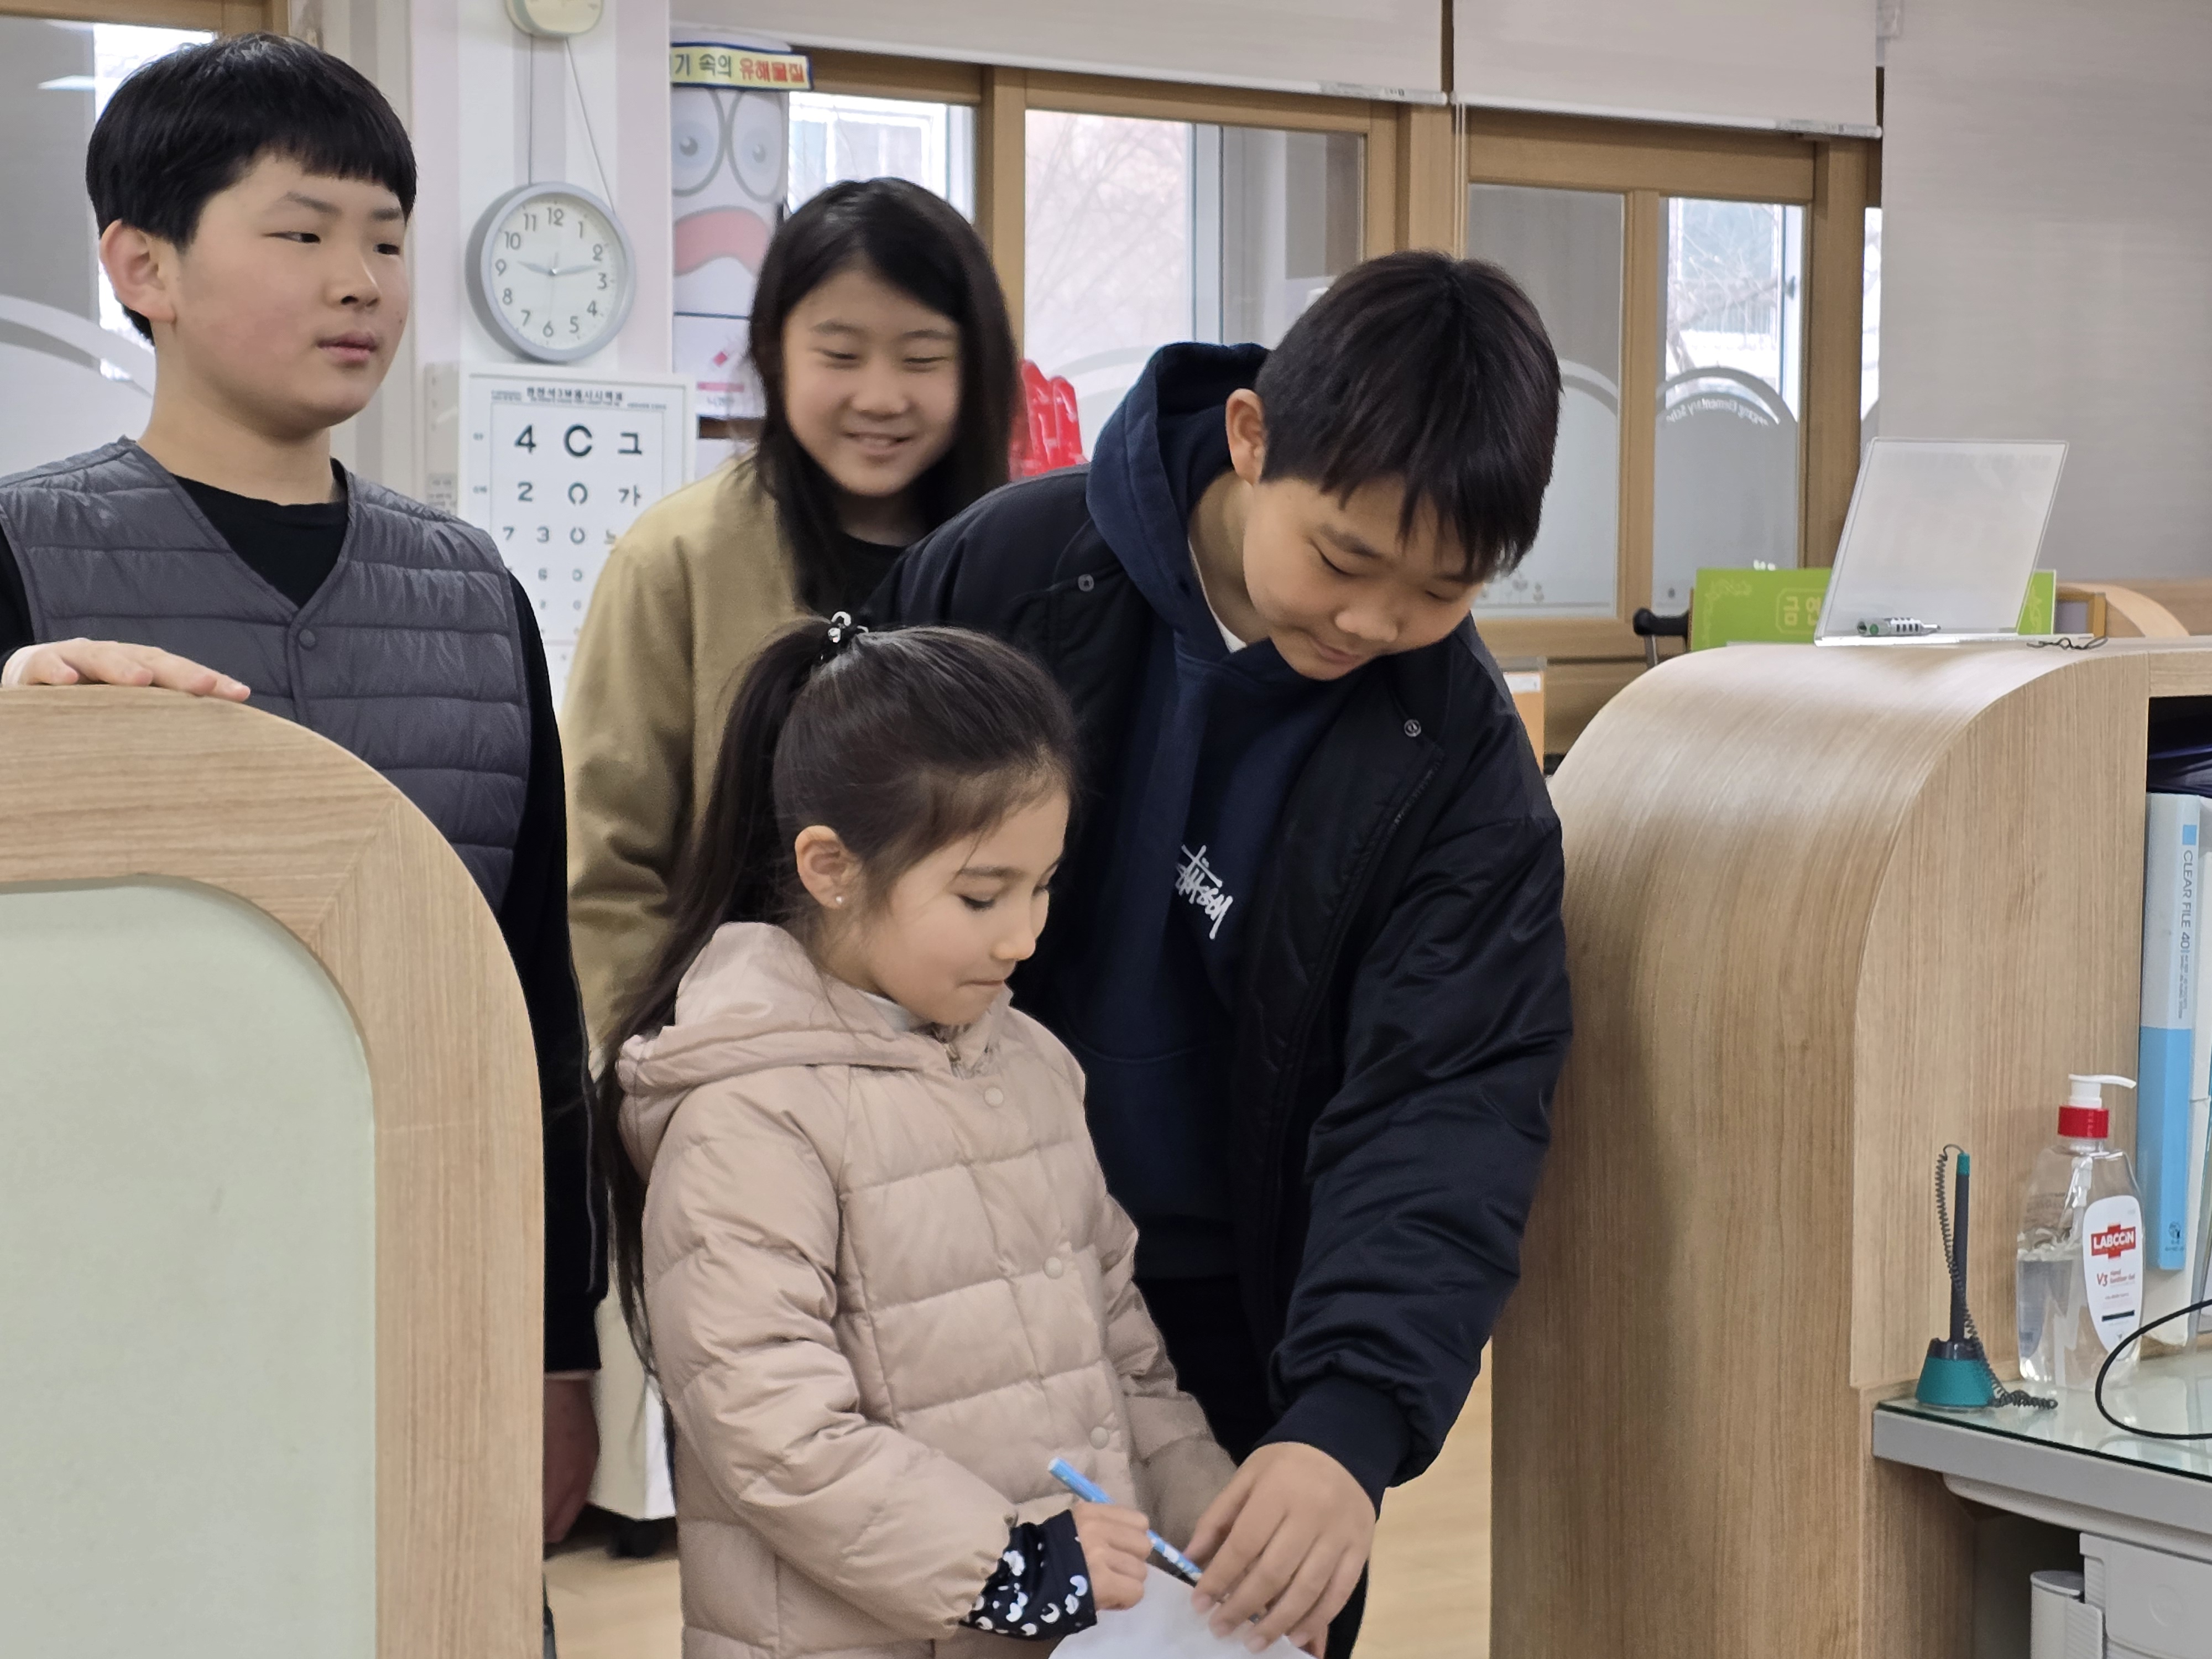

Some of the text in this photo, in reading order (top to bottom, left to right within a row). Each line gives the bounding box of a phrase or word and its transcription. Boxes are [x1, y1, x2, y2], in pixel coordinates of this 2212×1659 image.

[699, 53, 732, 78] 속의
[524, 213, 536, 231] 11
[547, 206, 564, 226] 12
[578, 221, 583, 239] 1
[505, 231, 521, 249] 10
[592, 243, 603, 262] 2
[495, 258, 507, 276] 9
[597, 272, 607, 290] 3
[502, 288, 513, 305] 8
[521, 309, 531, 326] 7
[587, 300, 597, 317] 4
[542, 320, 554, 338] 6
[569, 316, 579, 333] 5
[515, 424, 536, 454] 4
[618, 431, 642, 455] 그
[518, 481, 641, 507] 2 가
[503, 526, 514, 541] 7
[537, 526, 549, 543] 3
[2183, 849, 2193, 899] CLEAR
[2181, 902, 2192, 928] FILE
[2180, 932, 2190, 950] 40
[2096, 1272, 2108, 1287] V3
